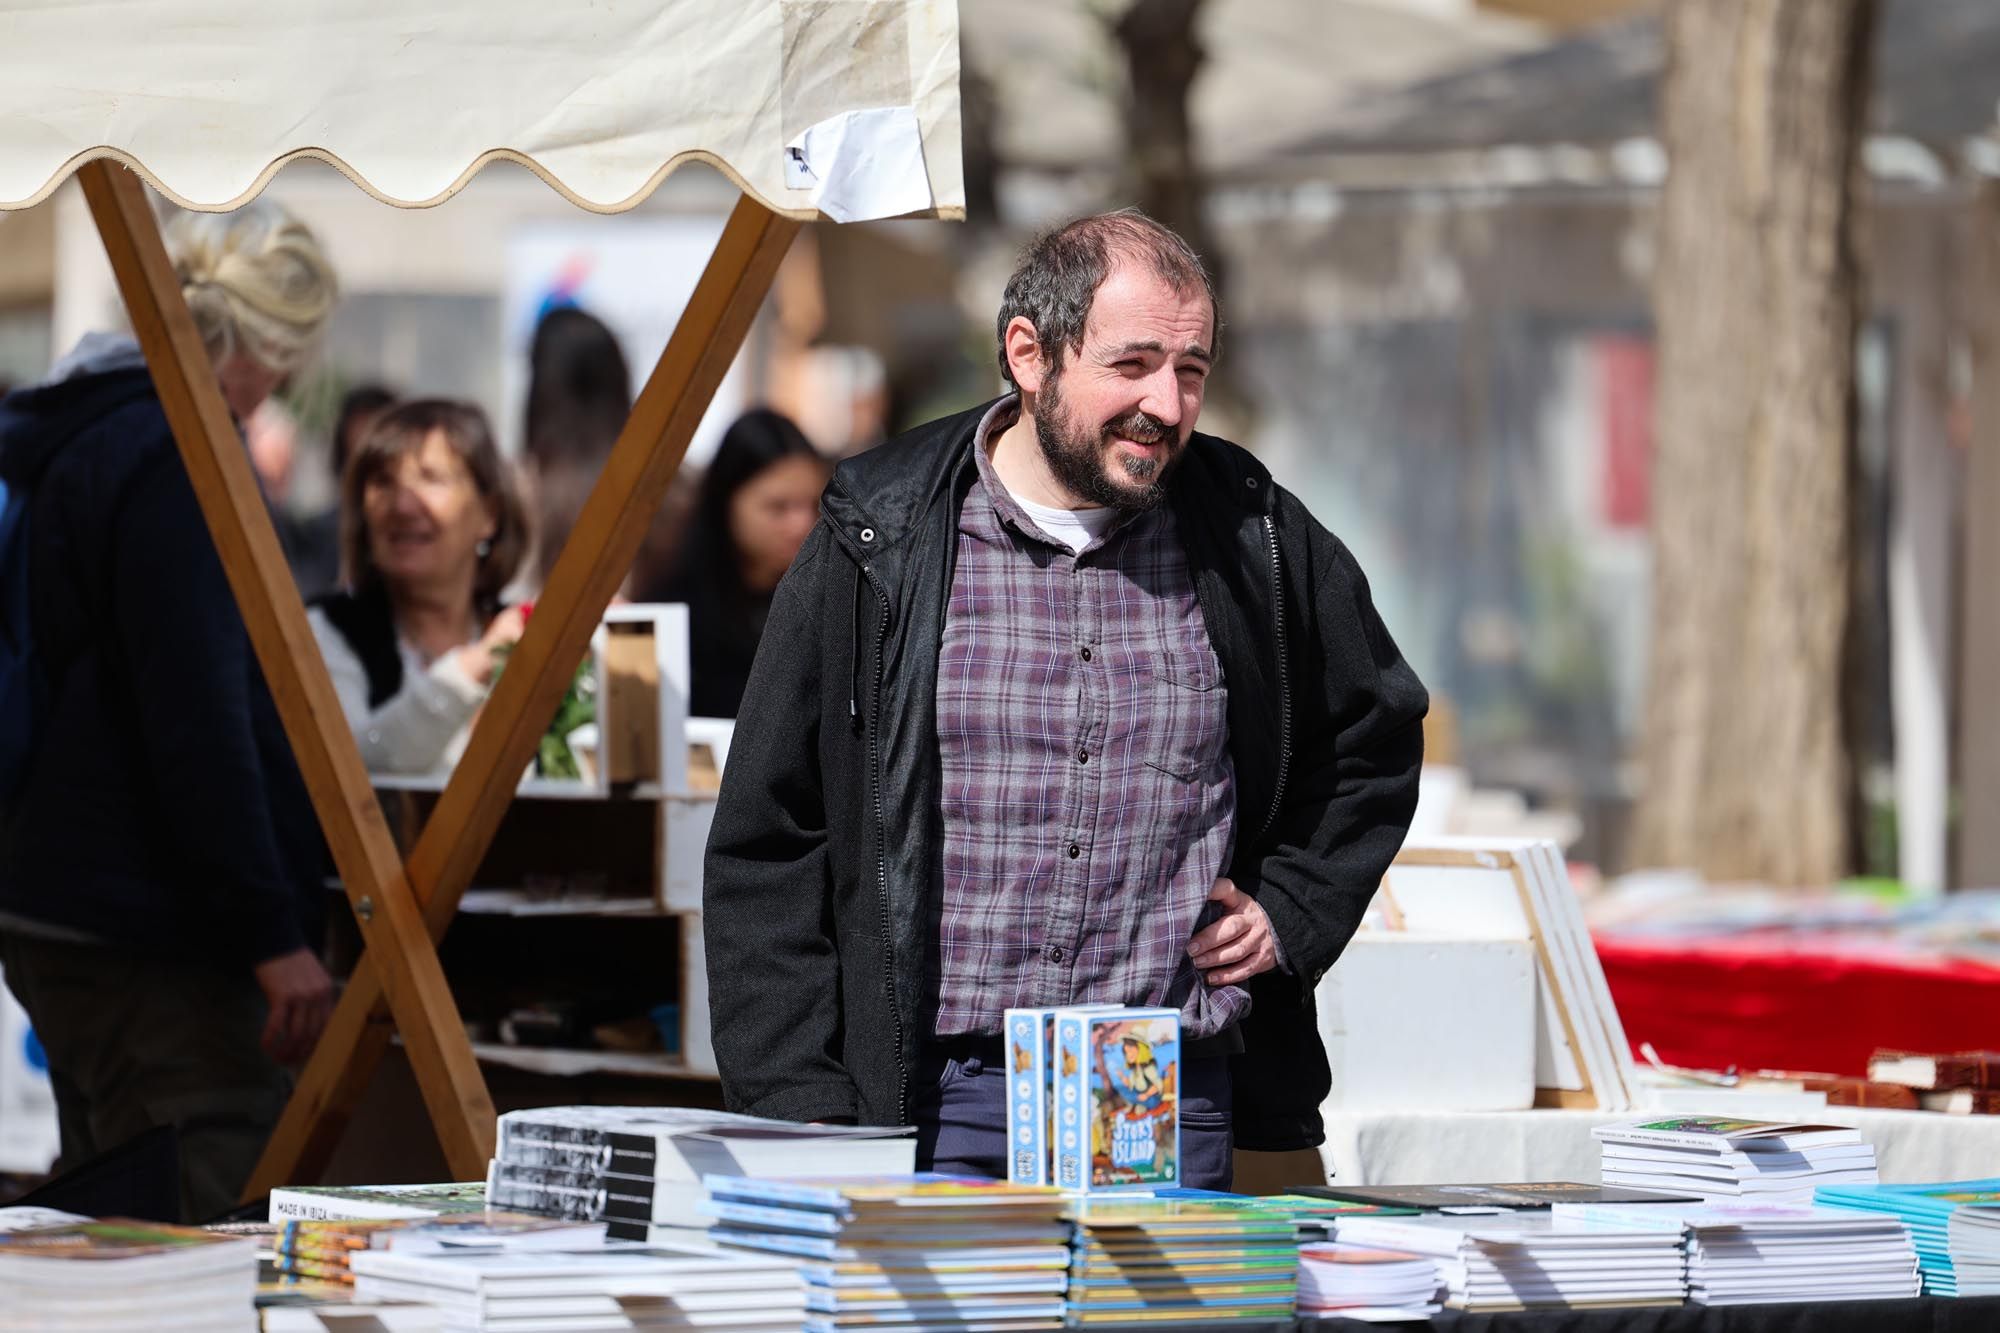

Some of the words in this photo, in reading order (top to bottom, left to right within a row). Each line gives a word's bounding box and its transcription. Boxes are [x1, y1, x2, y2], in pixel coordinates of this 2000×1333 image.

[277, 1203, 298, 1215] MADE
[299, 1206, 307, 1215] IN
[309, 1207, 328, 1219] IBIZA
